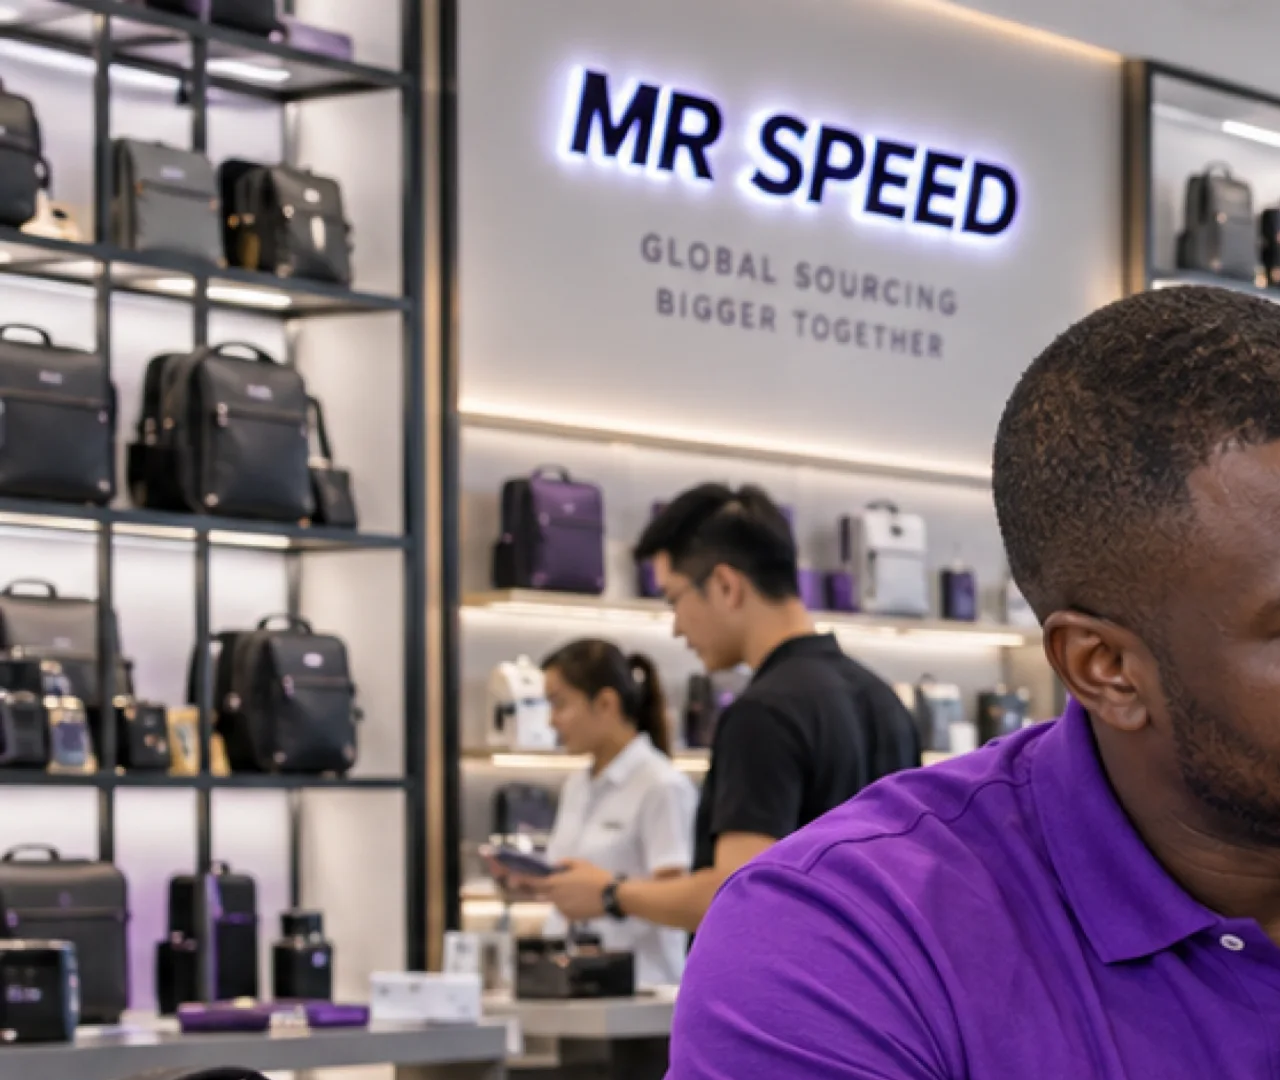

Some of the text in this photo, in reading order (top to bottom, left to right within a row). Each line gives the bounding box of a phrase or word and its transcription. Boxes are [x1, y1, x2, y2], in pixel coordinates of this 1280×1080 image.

[569, 68, 1020, 237] MR SPEED
[640, 232, 960, 316] GLOBAL SOURCING
[655, 287, 944, 359] BIGGER TOGETHER
